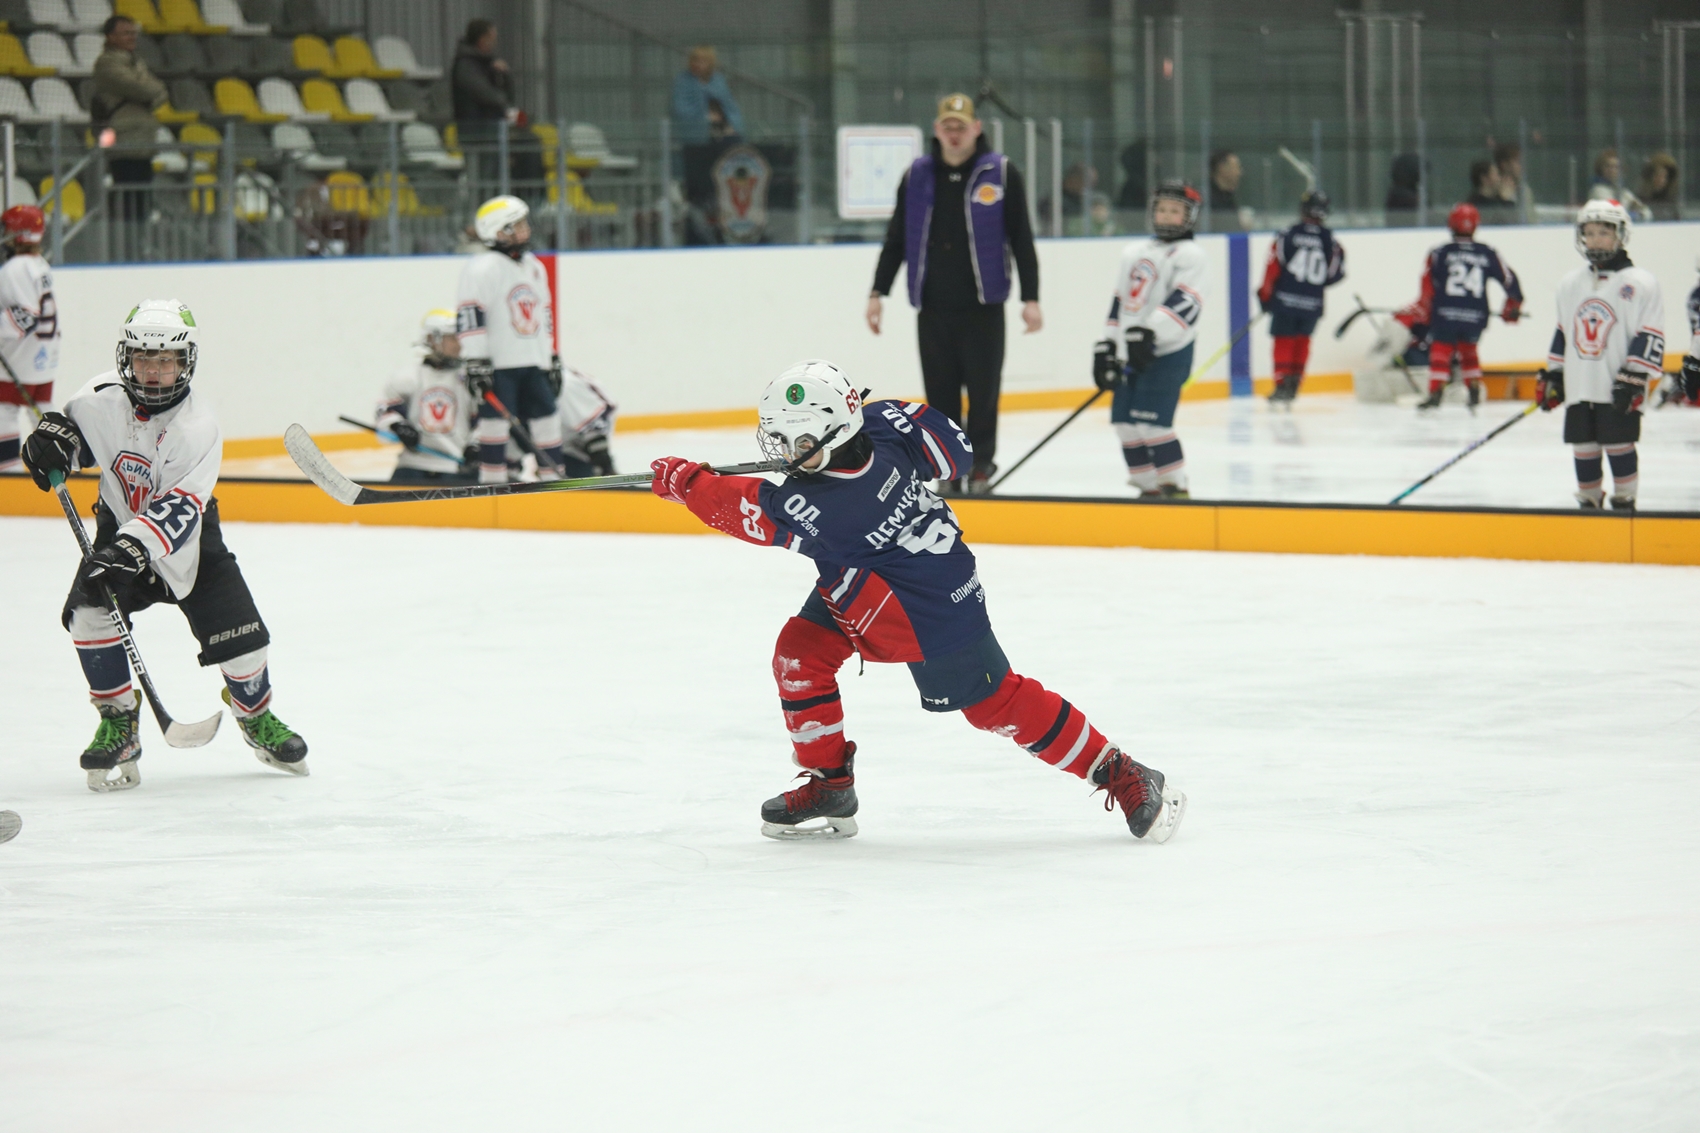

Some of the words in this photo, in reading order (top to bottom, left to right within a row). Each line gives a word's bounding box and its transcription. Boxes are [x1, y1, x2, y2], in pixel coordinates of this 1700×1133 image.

[1288, 249, 1328, 286] 40
[1445, 263, 1485, 298] 24
[1174, 294, 1199, 322] 71
[1643, 334, 1664, 364] 15
[845, 388, 861, 415] 69
[38, 421, 80, 448] BAUE
[801, 518, 820, 537] 2015
[208, 621, 260, 646] BAUER
